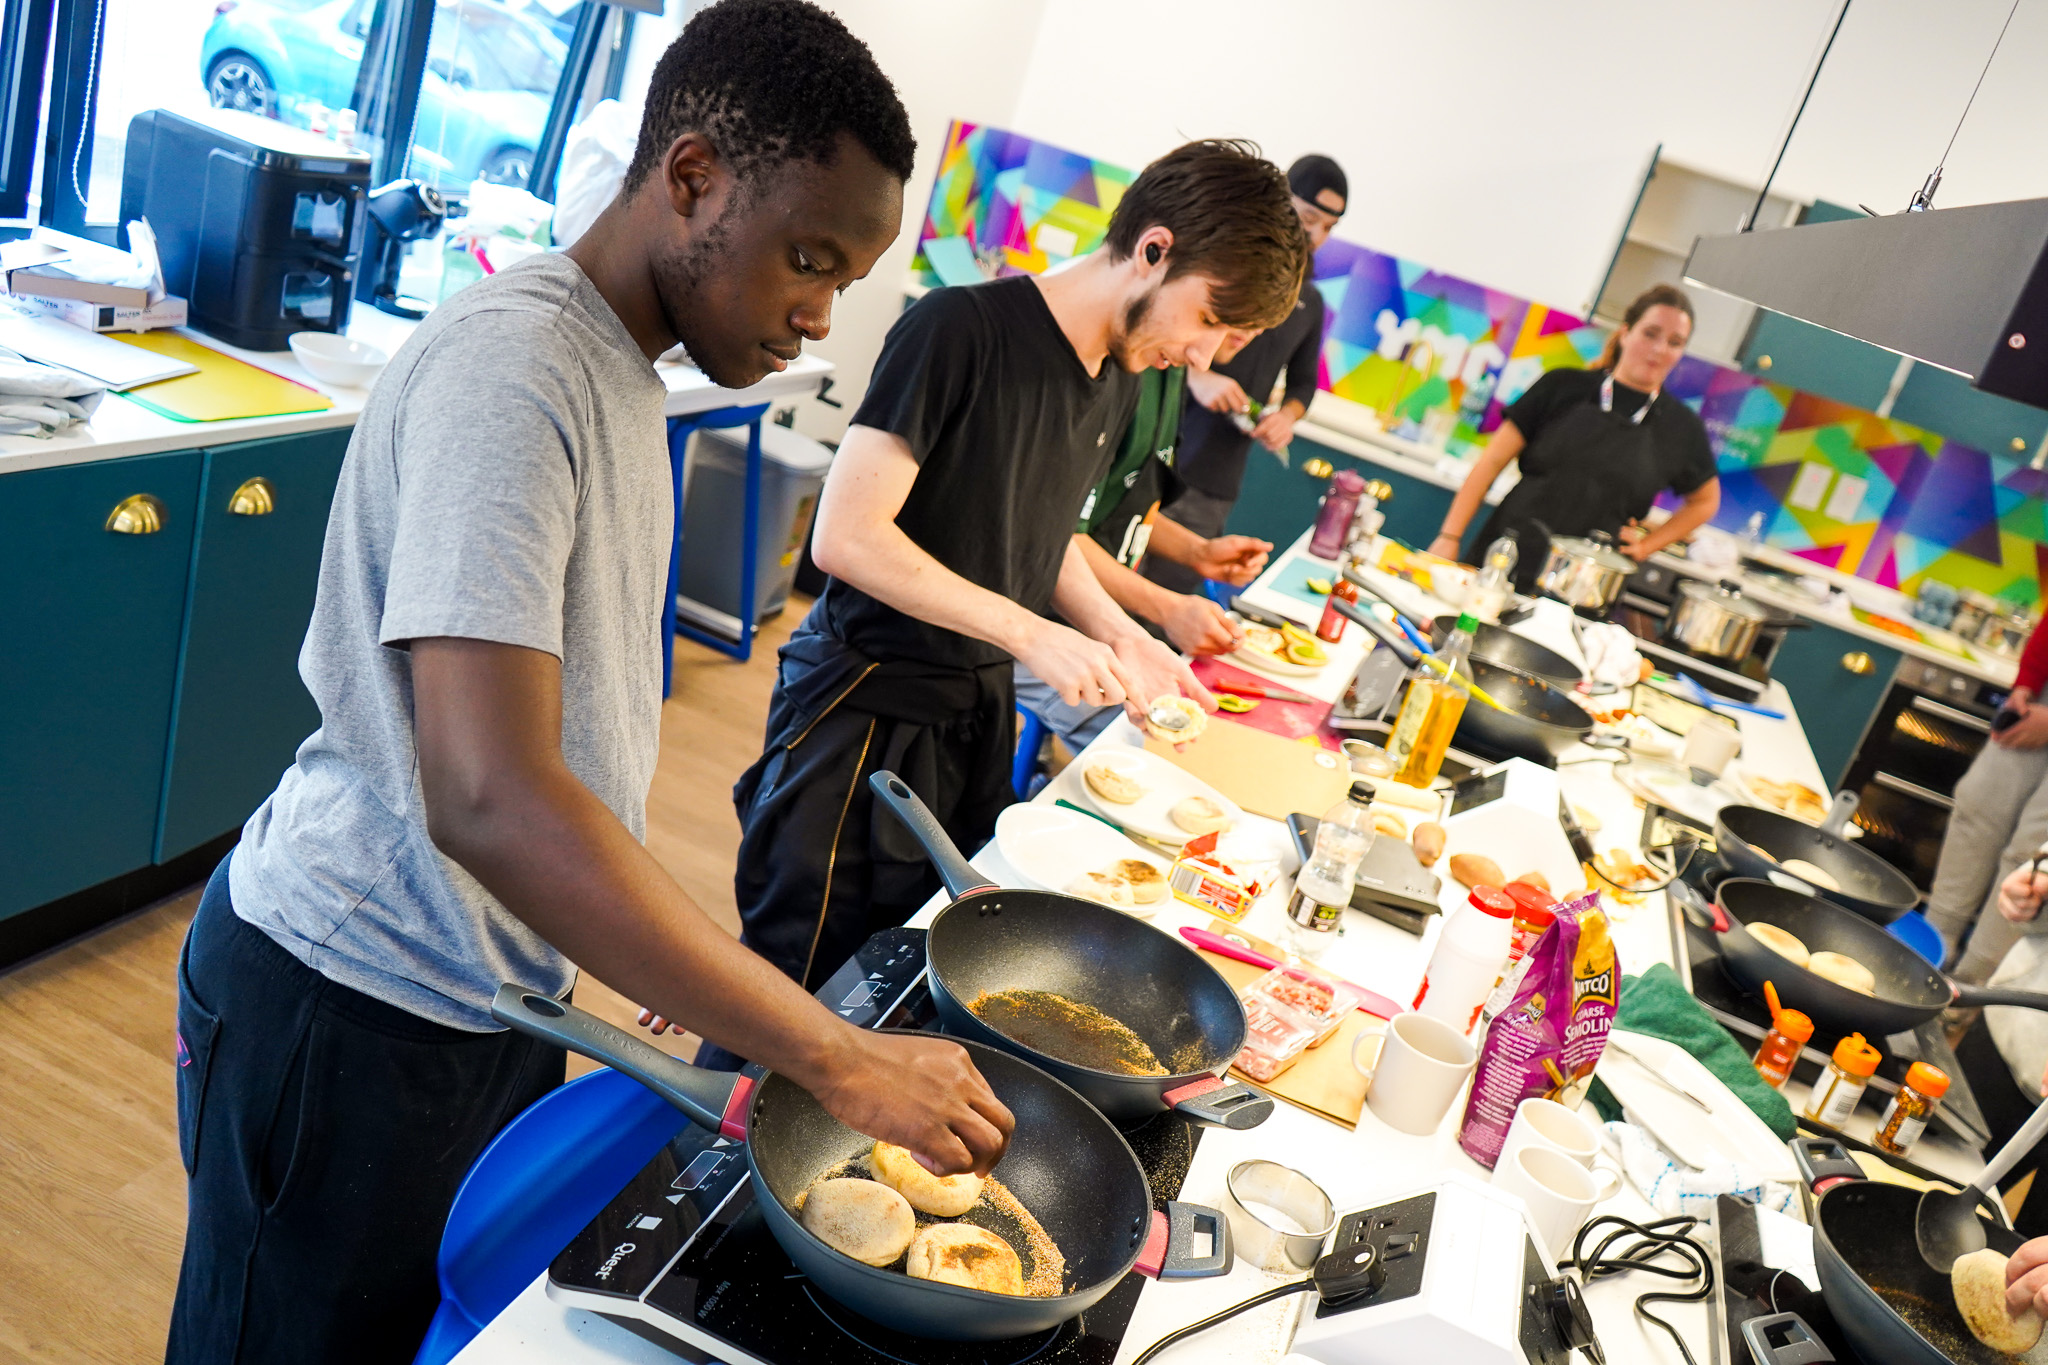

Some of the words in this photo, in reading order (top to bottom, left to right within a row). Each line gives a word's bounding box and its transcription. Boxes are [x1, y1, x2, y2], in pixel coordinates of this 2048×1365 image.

[1575, 974, 1609, 1002] NATCO
[1576, 1005, 1606, 1021] COARSE
[1564, 1016, 1615, 1045] SEMOLIN
[595, 1242, 636, 1279] Quest
[715, 1280, 731, 1295] Max
